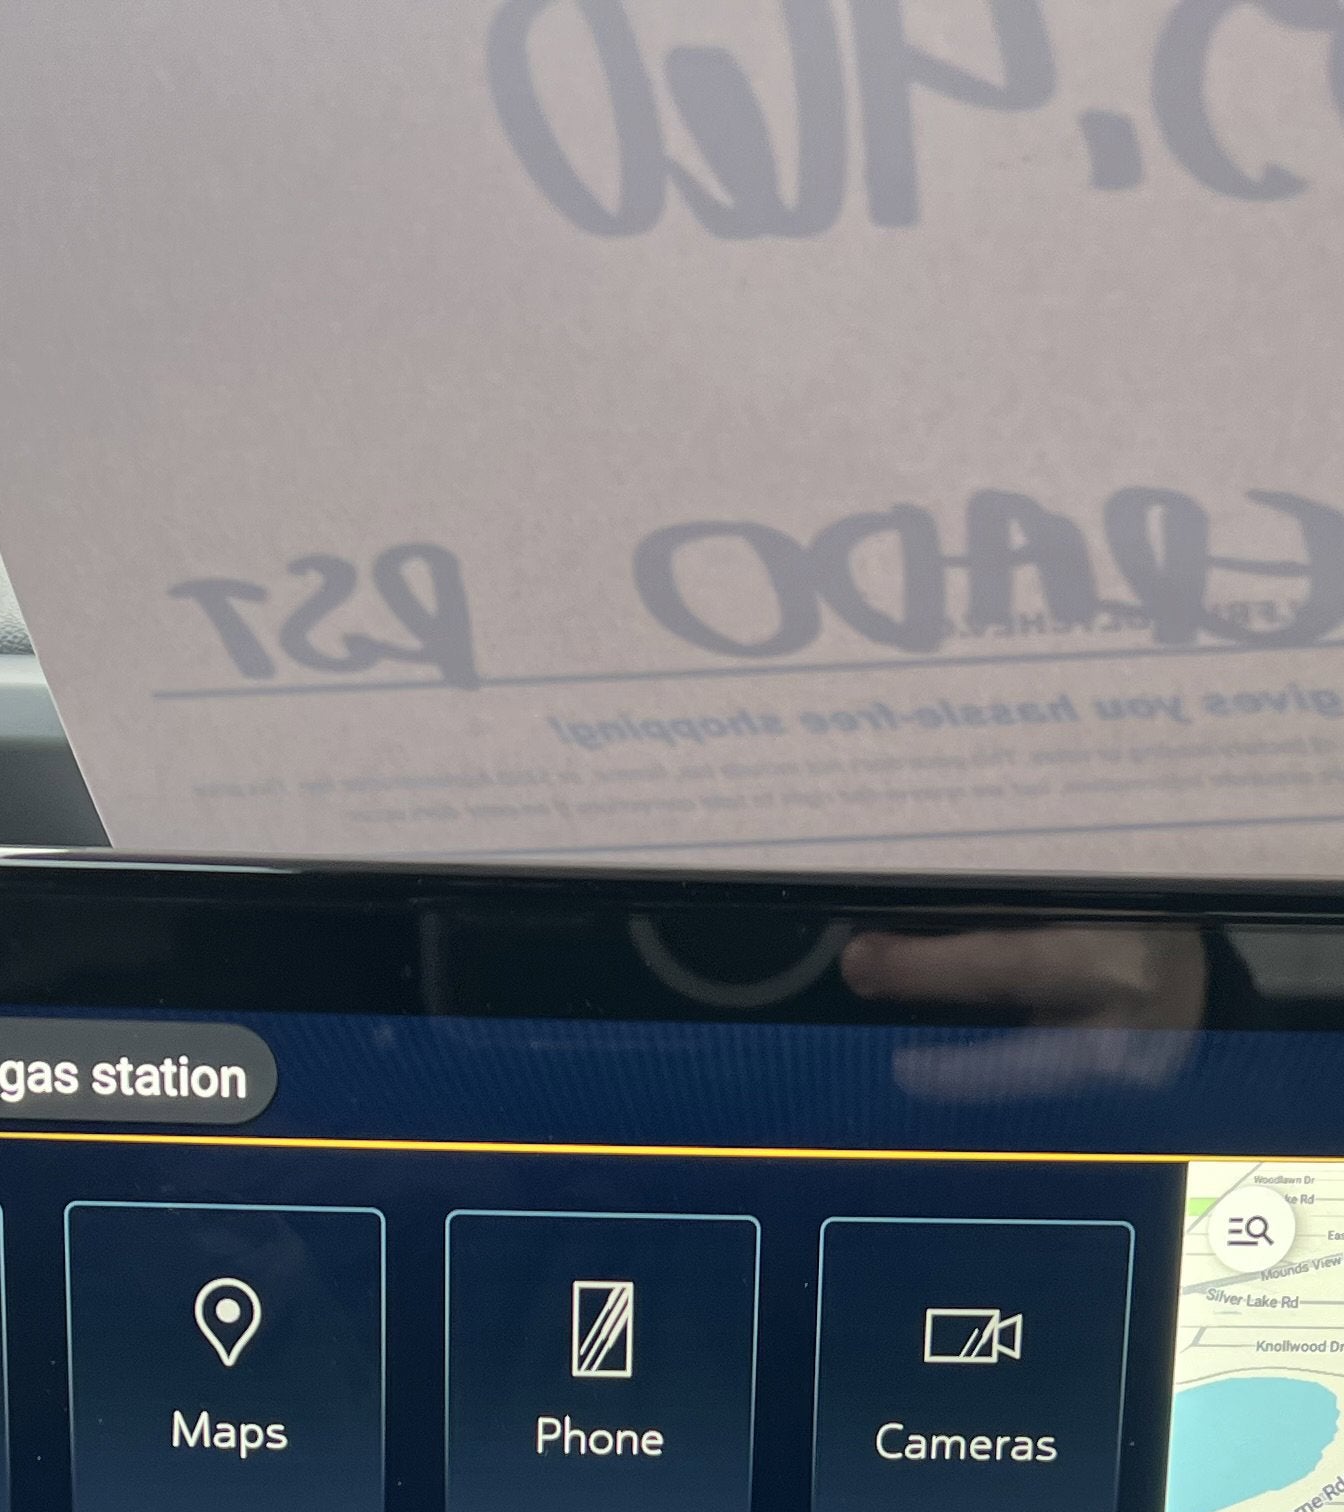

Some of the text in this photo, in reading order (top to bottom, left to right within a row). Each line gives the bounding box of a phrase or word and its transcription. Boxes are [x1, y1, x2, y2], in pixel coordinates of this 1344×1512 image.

[0, 1062, 79, 1104] gas
[91, 1054, 248, 1098] station
[1304, 1175, 1315, 1185] Dr
[1301, 1194, 1315, 1204] Rd
[1260, 1262, 1310, 1281] Mounds
[1312, 1255, 1343, 1270] View
[1206, 1288, 1299, 1309] Silver Lake Rd
[1256, 1340, 1327, 1353] Knollwood
[171, 1411, 288, 1458] Maps
[536, 1416, 664, 1457] Phone
[874, 1423, 1058, 1462] Cameras
